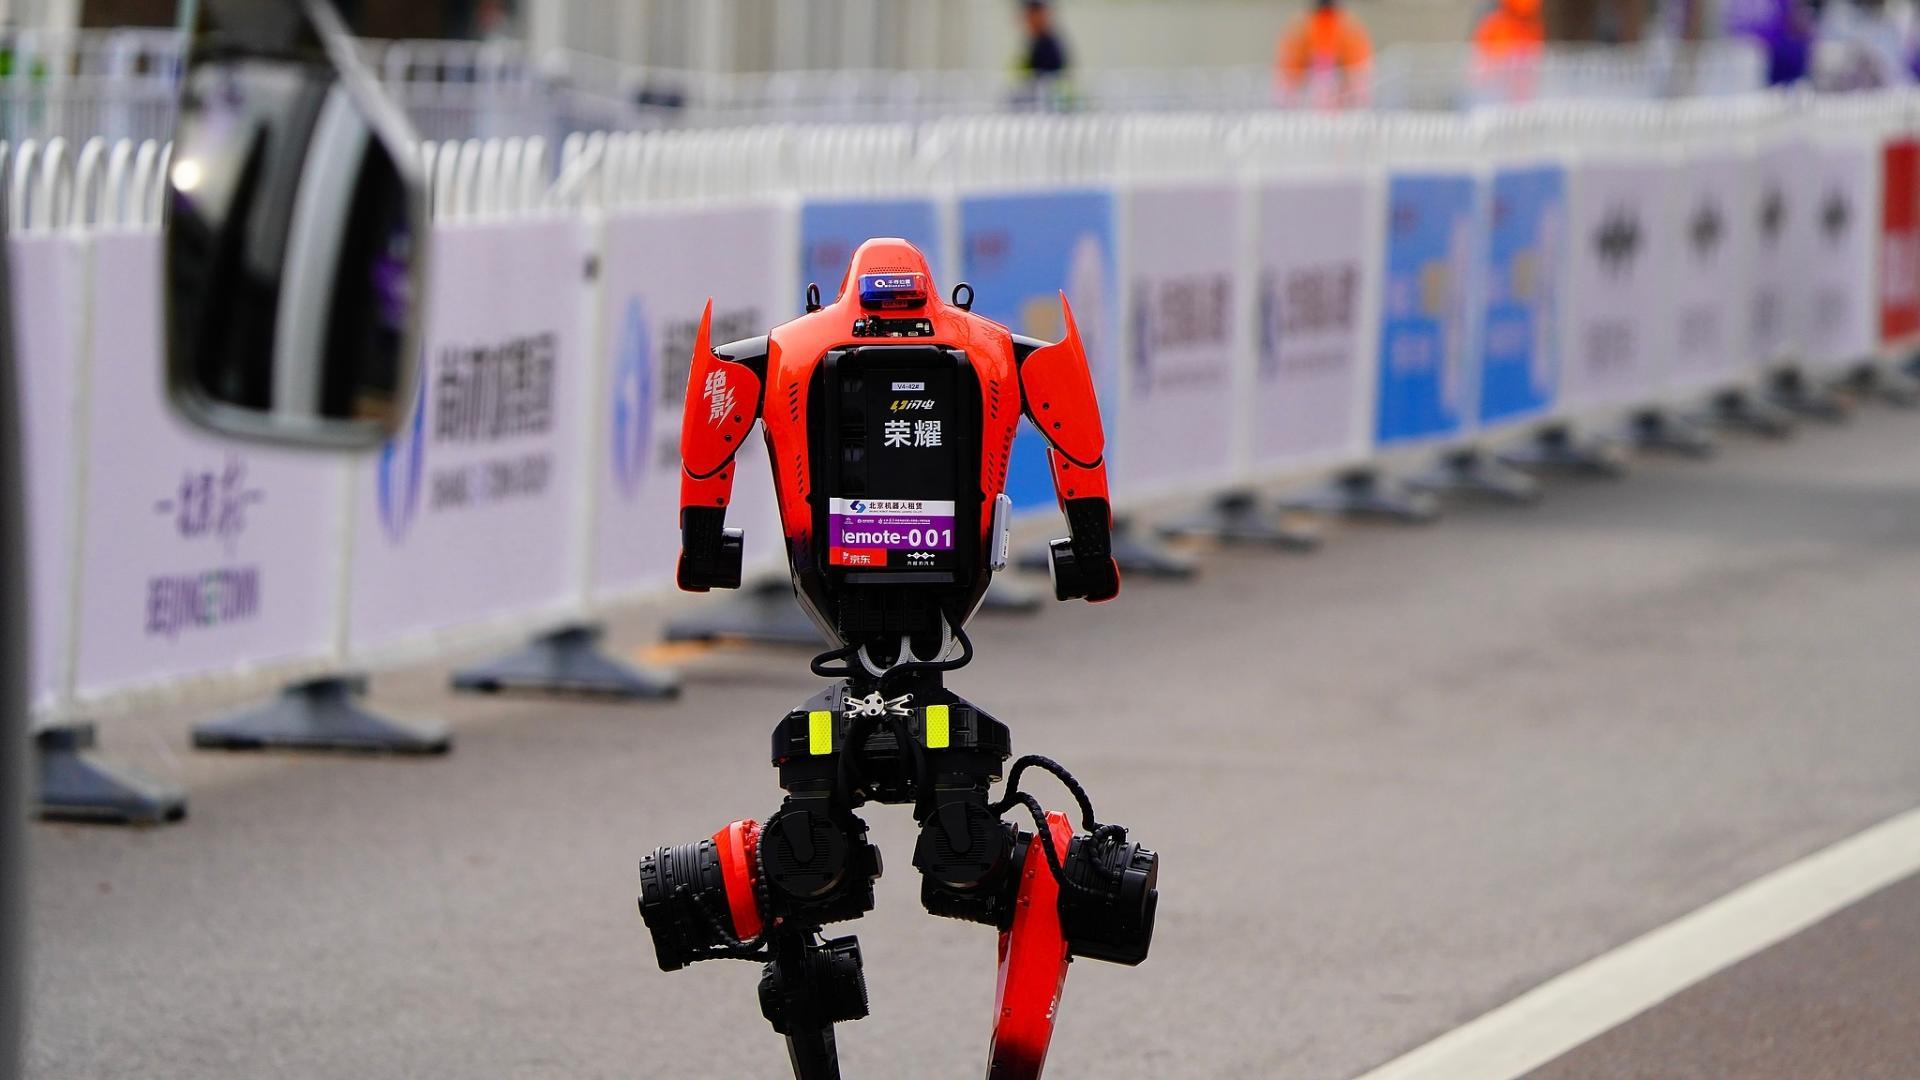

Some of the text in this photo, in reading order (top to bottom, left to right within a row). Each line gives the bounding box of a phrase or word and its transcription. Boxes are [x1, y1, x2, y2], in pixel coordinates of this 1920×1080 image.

[703, 368, 736, 429] 绝影
[884, 420, 942, 447] 荣耀
[868, 501, 923, 510] 北京机器人租赁
[841, 529, 951, 547] emote-001
[849, 554, 871, 565] 京东
